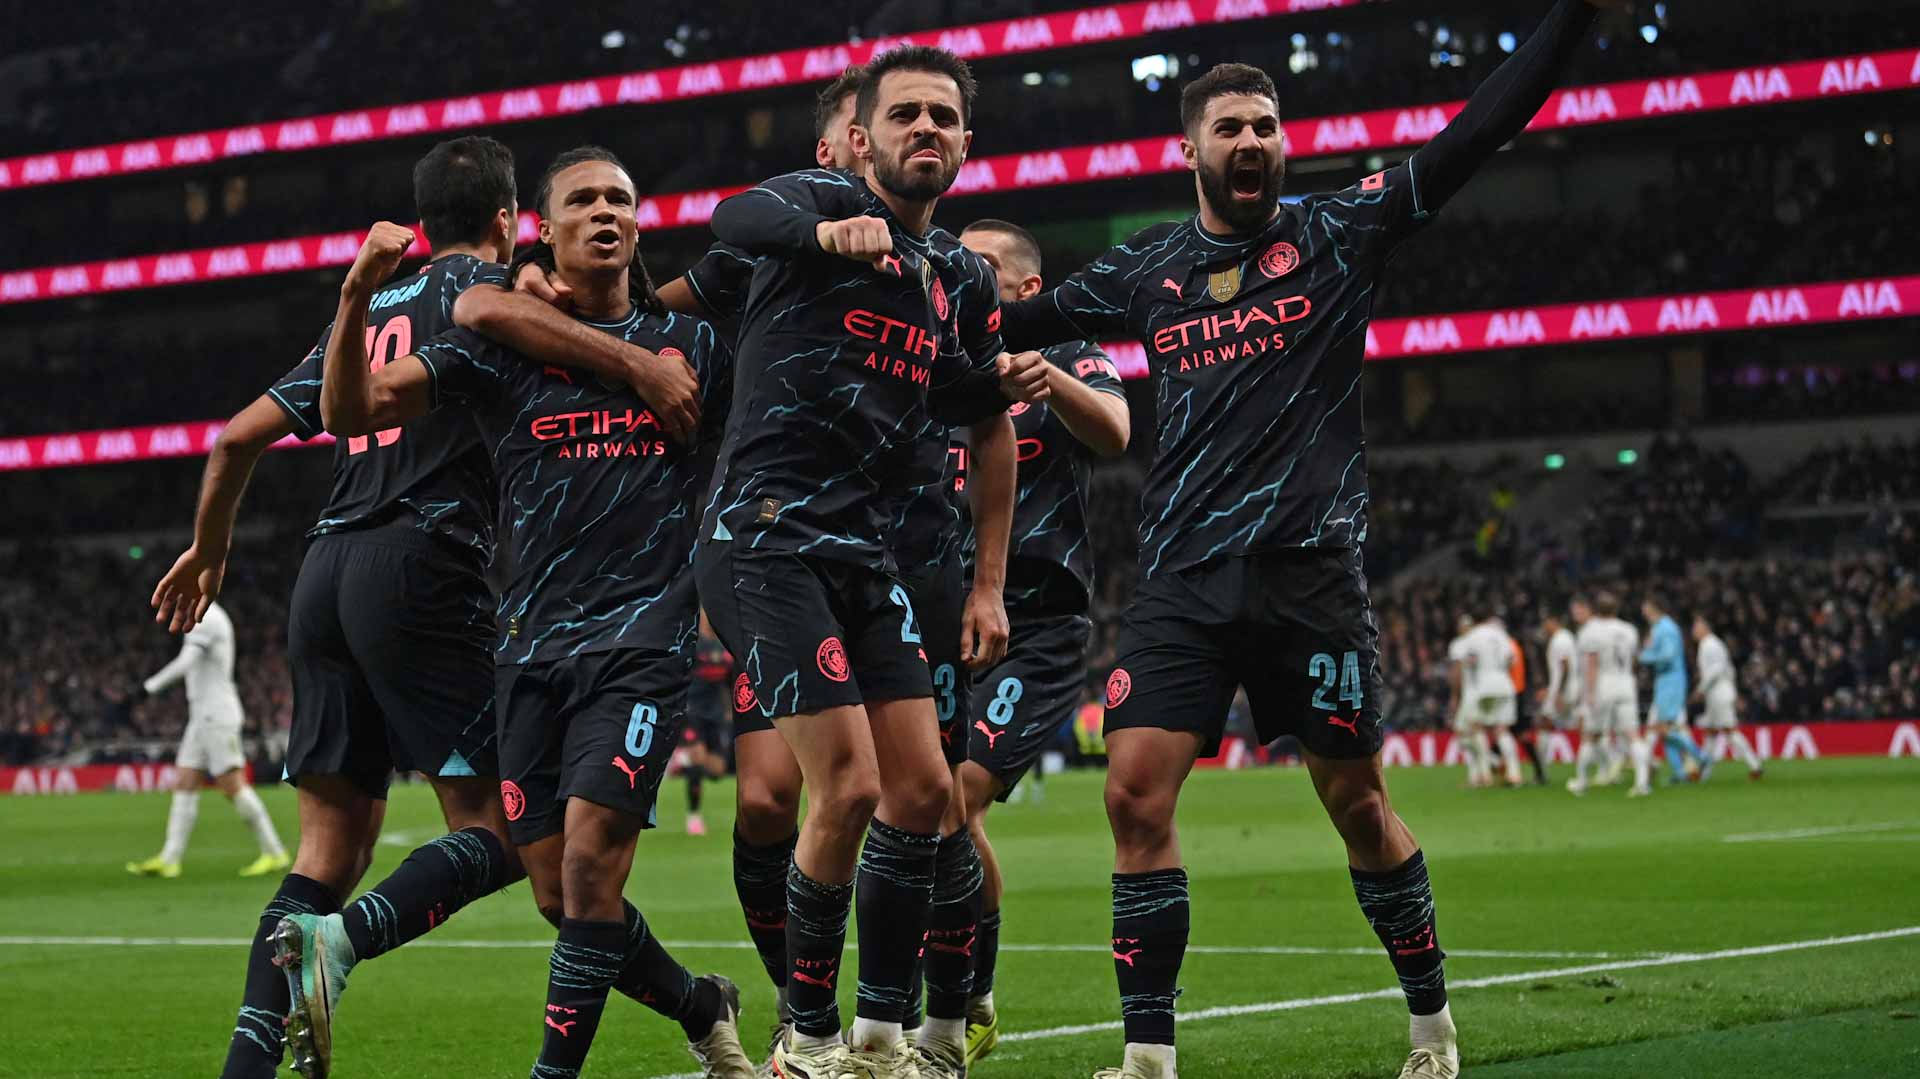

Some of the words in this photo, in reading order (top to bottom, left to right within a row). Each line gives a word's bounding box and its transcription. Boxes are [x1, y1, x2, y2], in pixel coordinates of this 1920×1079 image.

[1003, 19, 1053, 50] AIA
[1072, 9, 1123, 40] AIA
[1015, 153, 1067, 184] AIA
[1087, 145, 1140, 176] AIA
[1314, 117, 1369, 150] AIA
[1557, 88, 1615, 123] AIA
[1642, 78, 1701, 113] AIA
[1730, 68, 1790, 103] AIA
[1819, 57, 1880, 94] AIA
[843, 309, 938, 361] ETIH
[1154, 295, 1312, 354] ETIHAD
[1402, 317, 1460, 352] AIA
[1485, 310, 1544, 345] AIA
[1570, 303, 1630, 338] AIA
[1658, 296, 1718, 330] AIA
[1747, 289, 1808, 323] AIA
[1839, 281, 1901, 316] AIA
[864, 351, 931, 386] AIRW
[1180, 333, 1285, 373] AIRWAYS
[530, 409, 663, 441] ETIHA
[558, 441, 666, 459] AIRWAYS
[934, 663, 957, 722] 3
[986, 676, 1024, 726] 8
[1308, 650, 1364, 711] 24
[624, 702, 658, 758] 6
[12, 768, 79, 794] AIA
[795, 957, 837, 969] CITY
